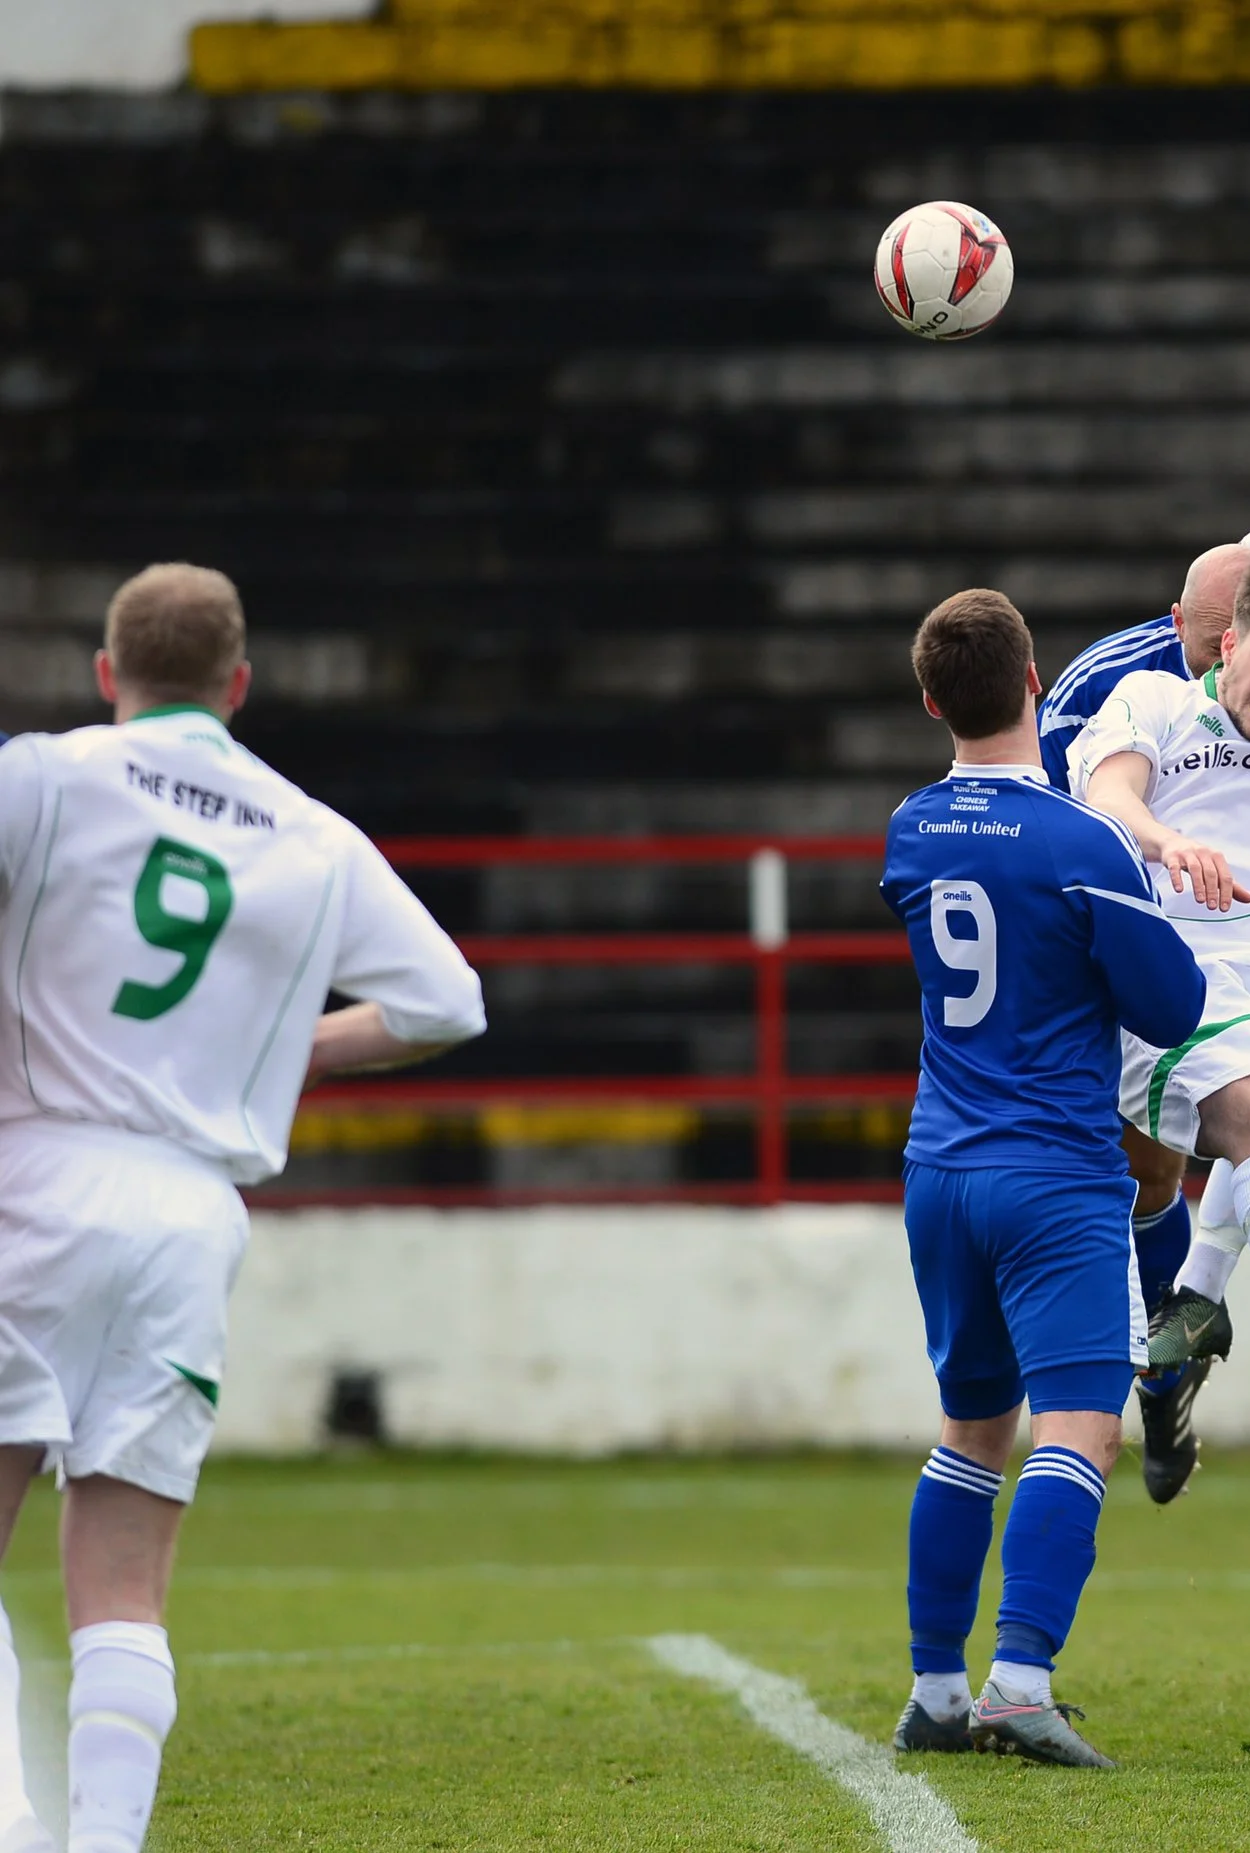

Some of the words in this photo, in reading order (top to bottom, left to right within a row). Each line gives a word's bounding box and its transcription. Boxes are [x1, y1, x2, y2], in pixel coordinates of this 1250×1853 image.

[127, 763, 167, 797] THE
[174, 780, 227, 820] STEP
[235, 801, 274, 829] INN
[950, 803, 990, 812] TAKEAWAY
[956, 795, 988, 804] CHINESE
[918, 819, 968, 834] Crumlin
[971, 821, 1021, 837] United
[111, 835, 233, 1020] 9
[930, 879, 997, 1028] 9
